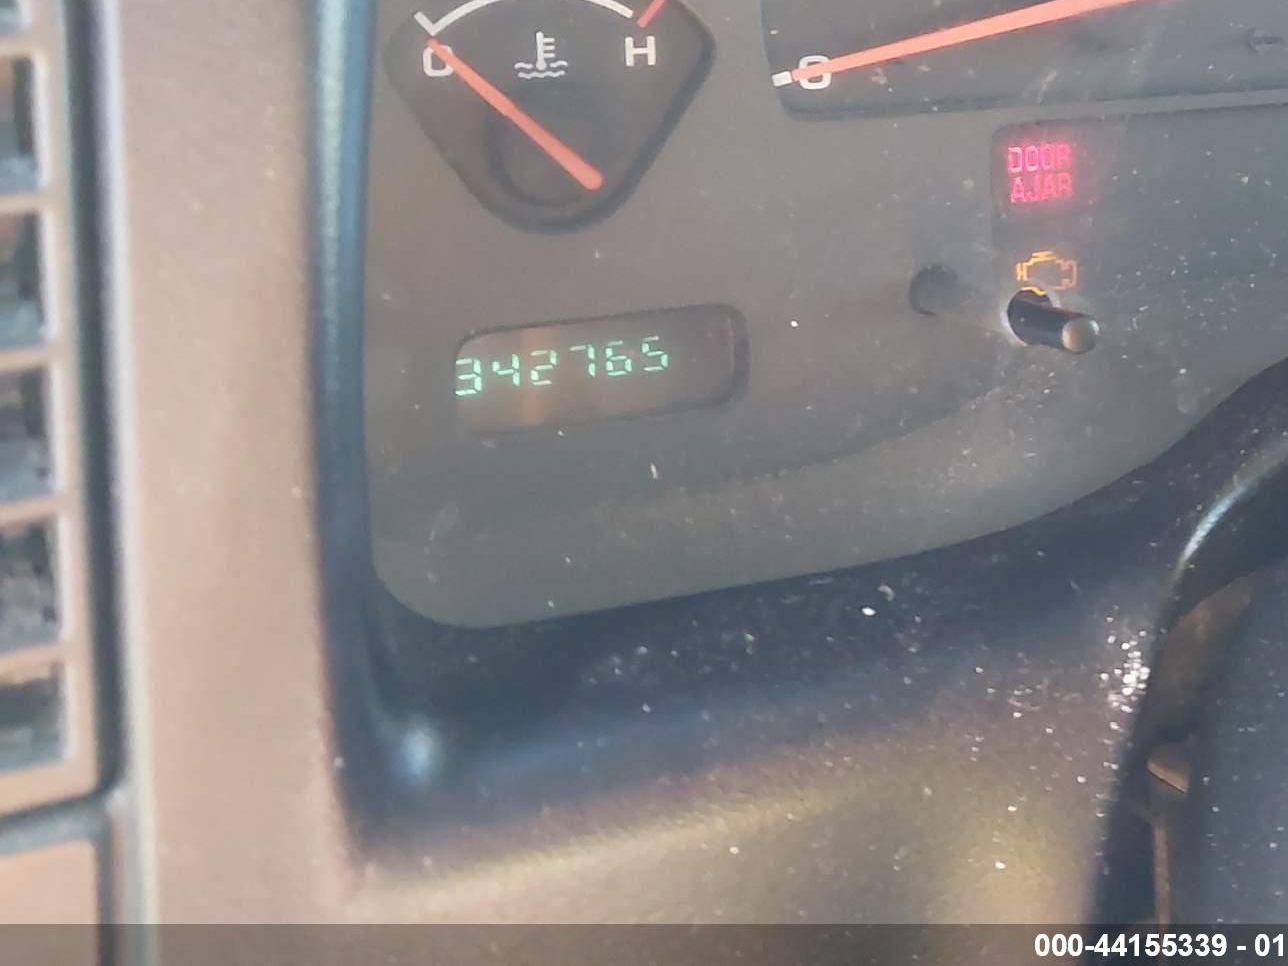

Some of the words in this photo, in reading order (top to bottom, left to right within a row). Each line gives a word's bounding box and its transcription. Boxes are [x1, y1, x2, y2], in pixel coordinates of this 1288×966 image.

[624, 36, 657, 67] H
[1008, 142, 1073, 173] DOOR
[1009, 172, 1073, 203] AJAR
[455, 336, 669, 396] 342765
